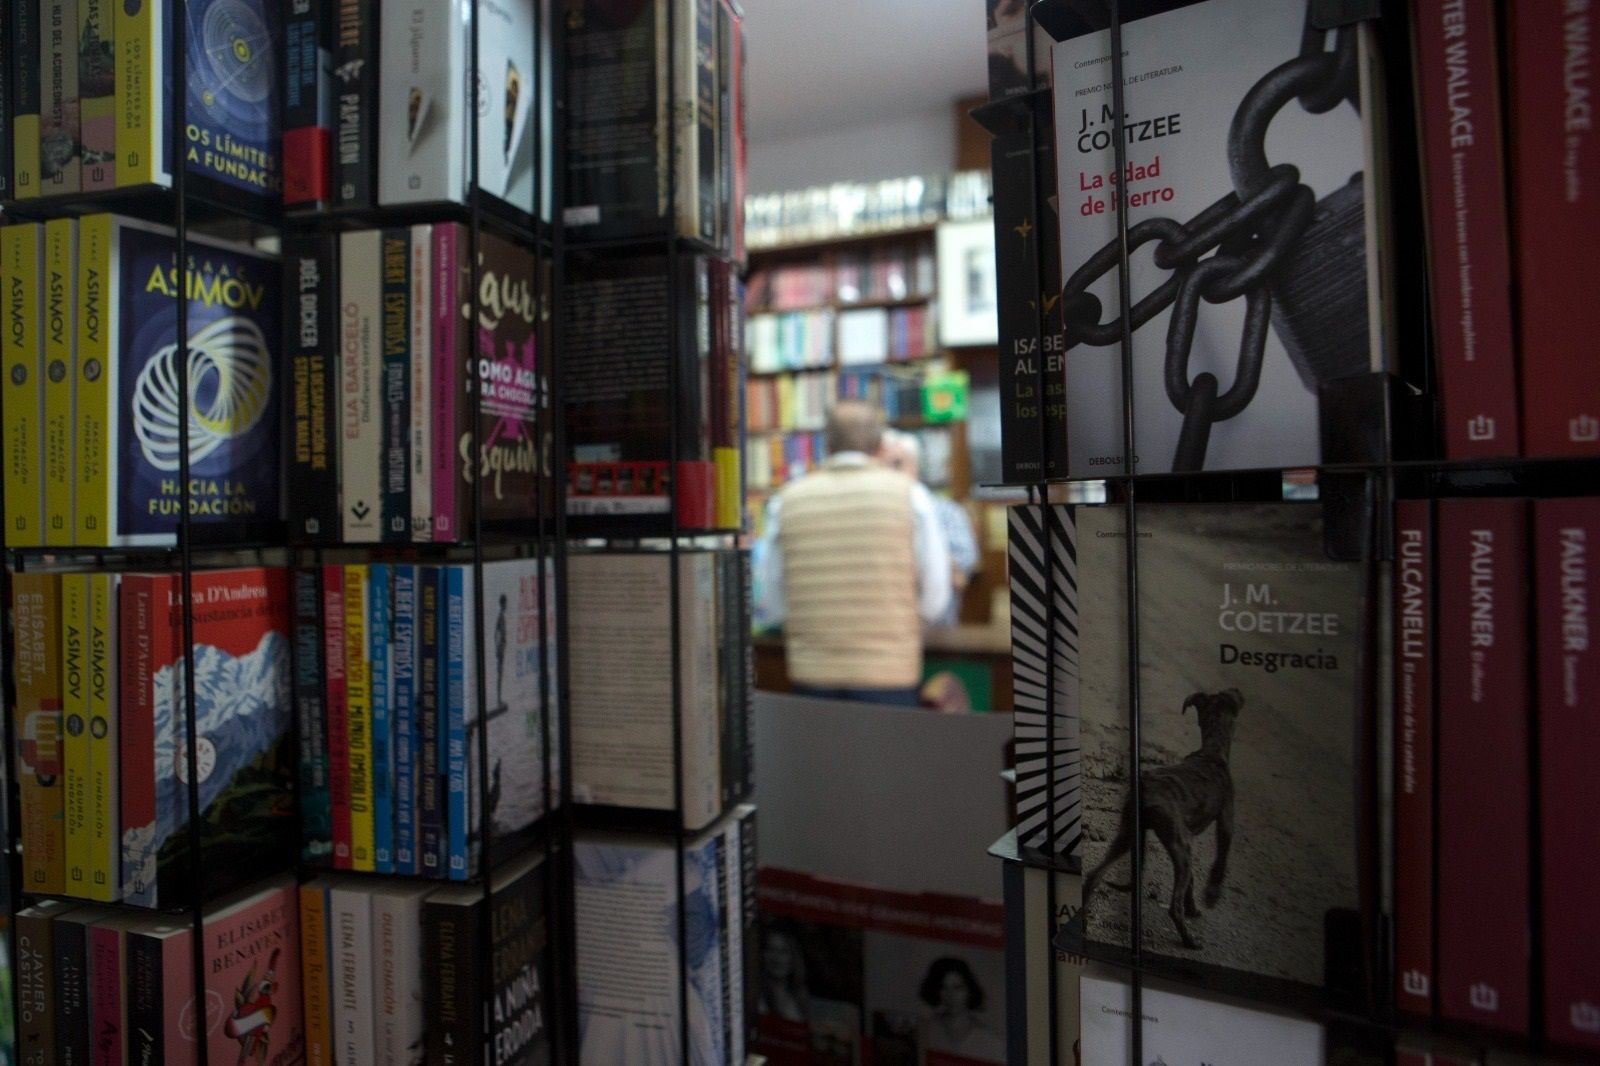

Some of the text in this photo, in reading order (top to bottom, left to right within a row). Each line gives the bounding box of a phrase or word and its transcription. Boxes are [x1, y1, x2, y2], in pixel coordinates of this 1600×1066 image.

[53, 5, 62, 127] HIJO DEL ACORDEONISTA
[1075, 65, 1184, 97] PREMIO NOL DE LITERATURA
[1563, 16, 1591, 131] WALLACE
[1079, 109, 1094, 134] J.
[1446, 41, 1474, 148] WALLACE
[185, 124, 210, 147] OS
[340, 94, 360, 164] PAPILLON
[1080, 172, 1103, 191] La
[1081, 196, 1105, 216] de
[11, 277, 24, 348] ASIMOV
[50, 272, 63, 344] ASIMOV
[86, 269, 99, 343] ASIMOV
[145, 263, 264, 310] ASIMOV
[300, 294, 318, 347] DICKER
[384, 292, 407, 355] ESPINOSA
[1014, 335, 1063, 354] ISABE
[466, 358, 512, 381] OMO
[347, 400, 359, 439] ELIA
[137, 592, 148, 630] Luca
[395, 575, 412, 619] ALBERT
[1219, 583, 1278, 609] J. M.
[1401, 529, 1424, 658] FULCANELLI
[1470, 529, 1494, 647] FAULKNER
[1559, 528, 1589, 651] FAULKNER
[17, 594, 32, 685] BENAVENT
[395, 623, 412, 679] ESPINOSA
[1219, 611, 1340, 636] COETZEE
[67, 626, 80, 699] ASIMOV
[92, 627, 105, 700] ASIMOV
[1220, 643, 1339, 673] Desgracia
[349, 705, 366, 748] MUNDO
[1403, 662, 1417, 793] El misterio de las catedrales
[341, 912, 354, 948] ELENA
[383, 912, 393, 956] DULCE
[20, 936, 32, 1023] CASTILLO
[33, 950, 44, 1013] JAVIER
[343, 953, 356, 1010] FERRANTE
